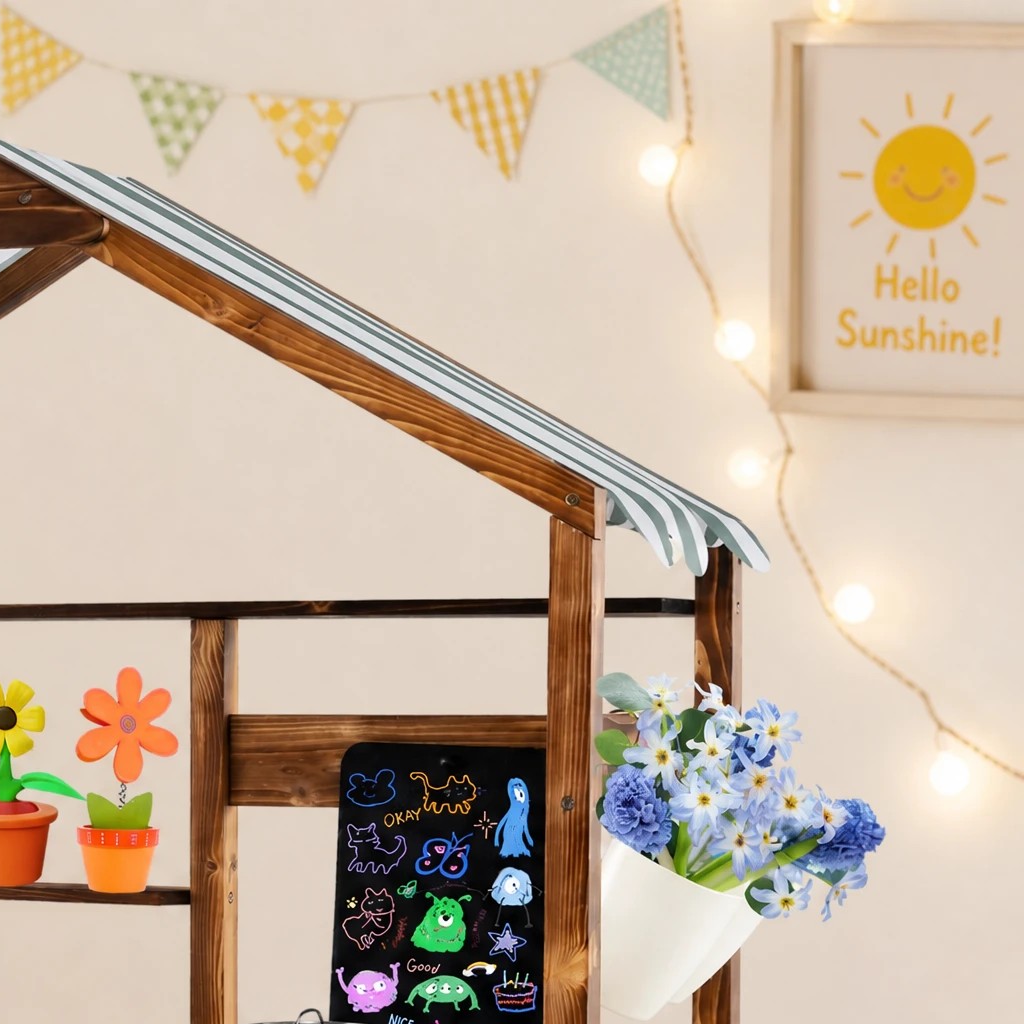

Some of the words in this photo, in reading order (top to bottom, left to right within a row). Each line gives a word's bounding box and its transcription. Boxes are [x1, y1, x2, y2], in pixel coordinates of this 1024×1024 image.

[874, 263, 960, 303] Hello
[836, 307, 1002, 358] Sunshine!
[384, 808, 422, 827] OKAY
[406, 958, 441, 974] Good
